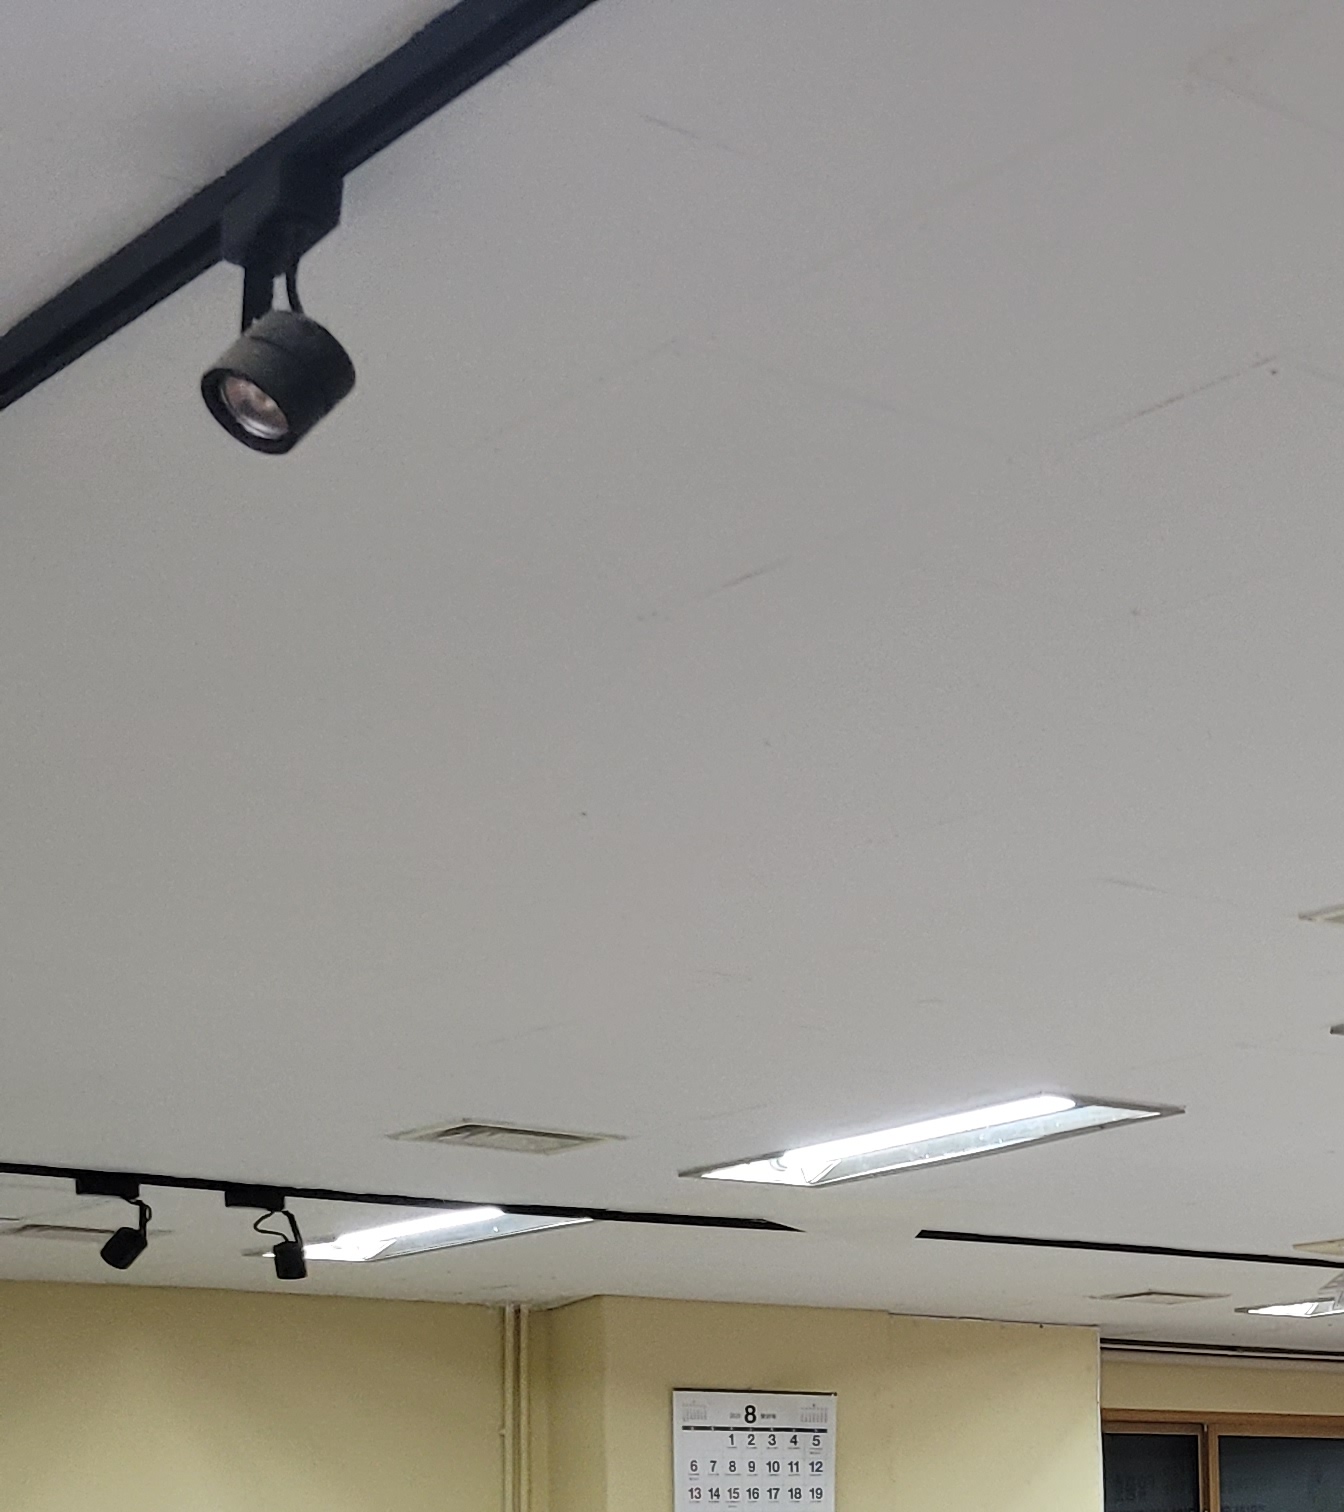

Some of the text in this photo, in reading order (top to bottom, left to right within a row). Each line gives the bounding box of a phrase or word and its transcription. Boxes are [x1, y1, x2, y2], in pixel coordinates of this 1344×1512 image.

[744, 1404, 757, 1424] 8
[728, 1434, 821, 1446] 1 2 3 4 5
[690, 1460, 823, 1473] 6 7 8 9 10 11 12
[688, 1487, 823, 1500] 13 14 15 16 17 18 19
